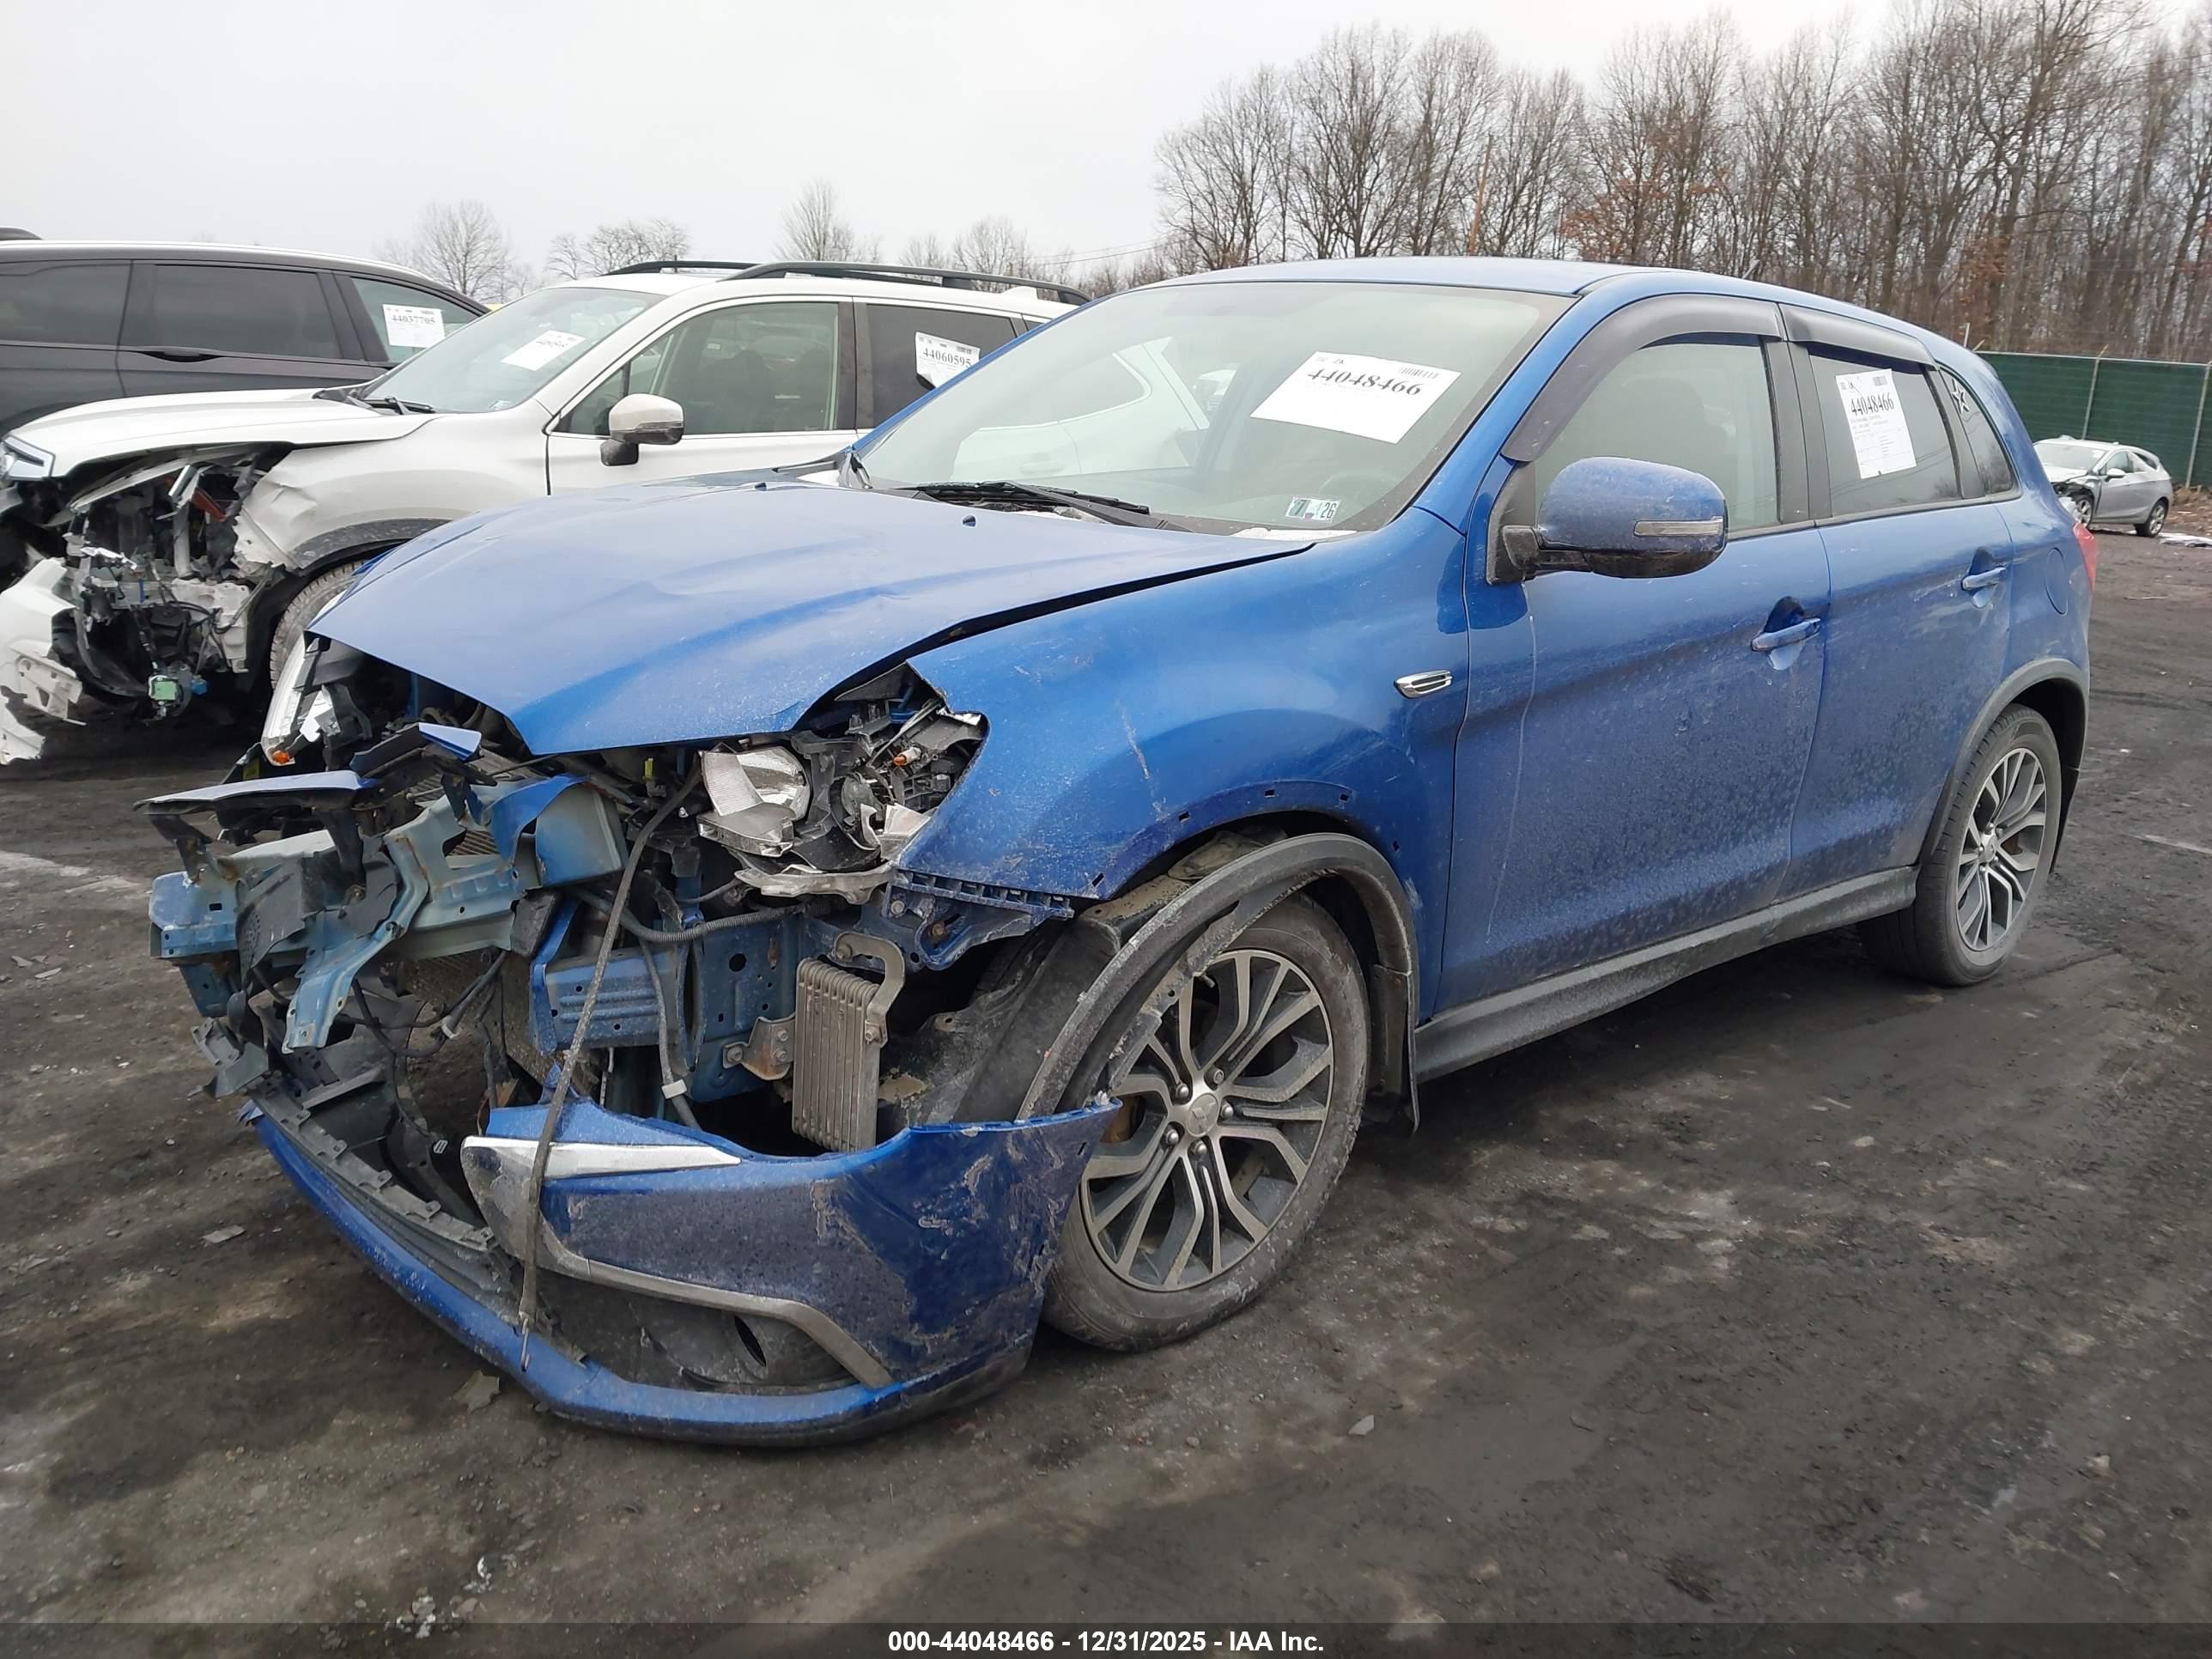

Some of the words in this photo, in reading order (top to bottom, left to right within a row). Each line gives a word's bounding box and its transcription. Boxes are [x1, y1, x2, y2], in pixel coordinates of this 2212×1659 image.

[392, 314, 435, 325] 44037705
[922, 348, 971, 368] 44060595
[1308, 368, 1425, 396] 44048466
[1851, 392, 1894, 416] 44048466
[1321, 501, 1337, 519] 26
